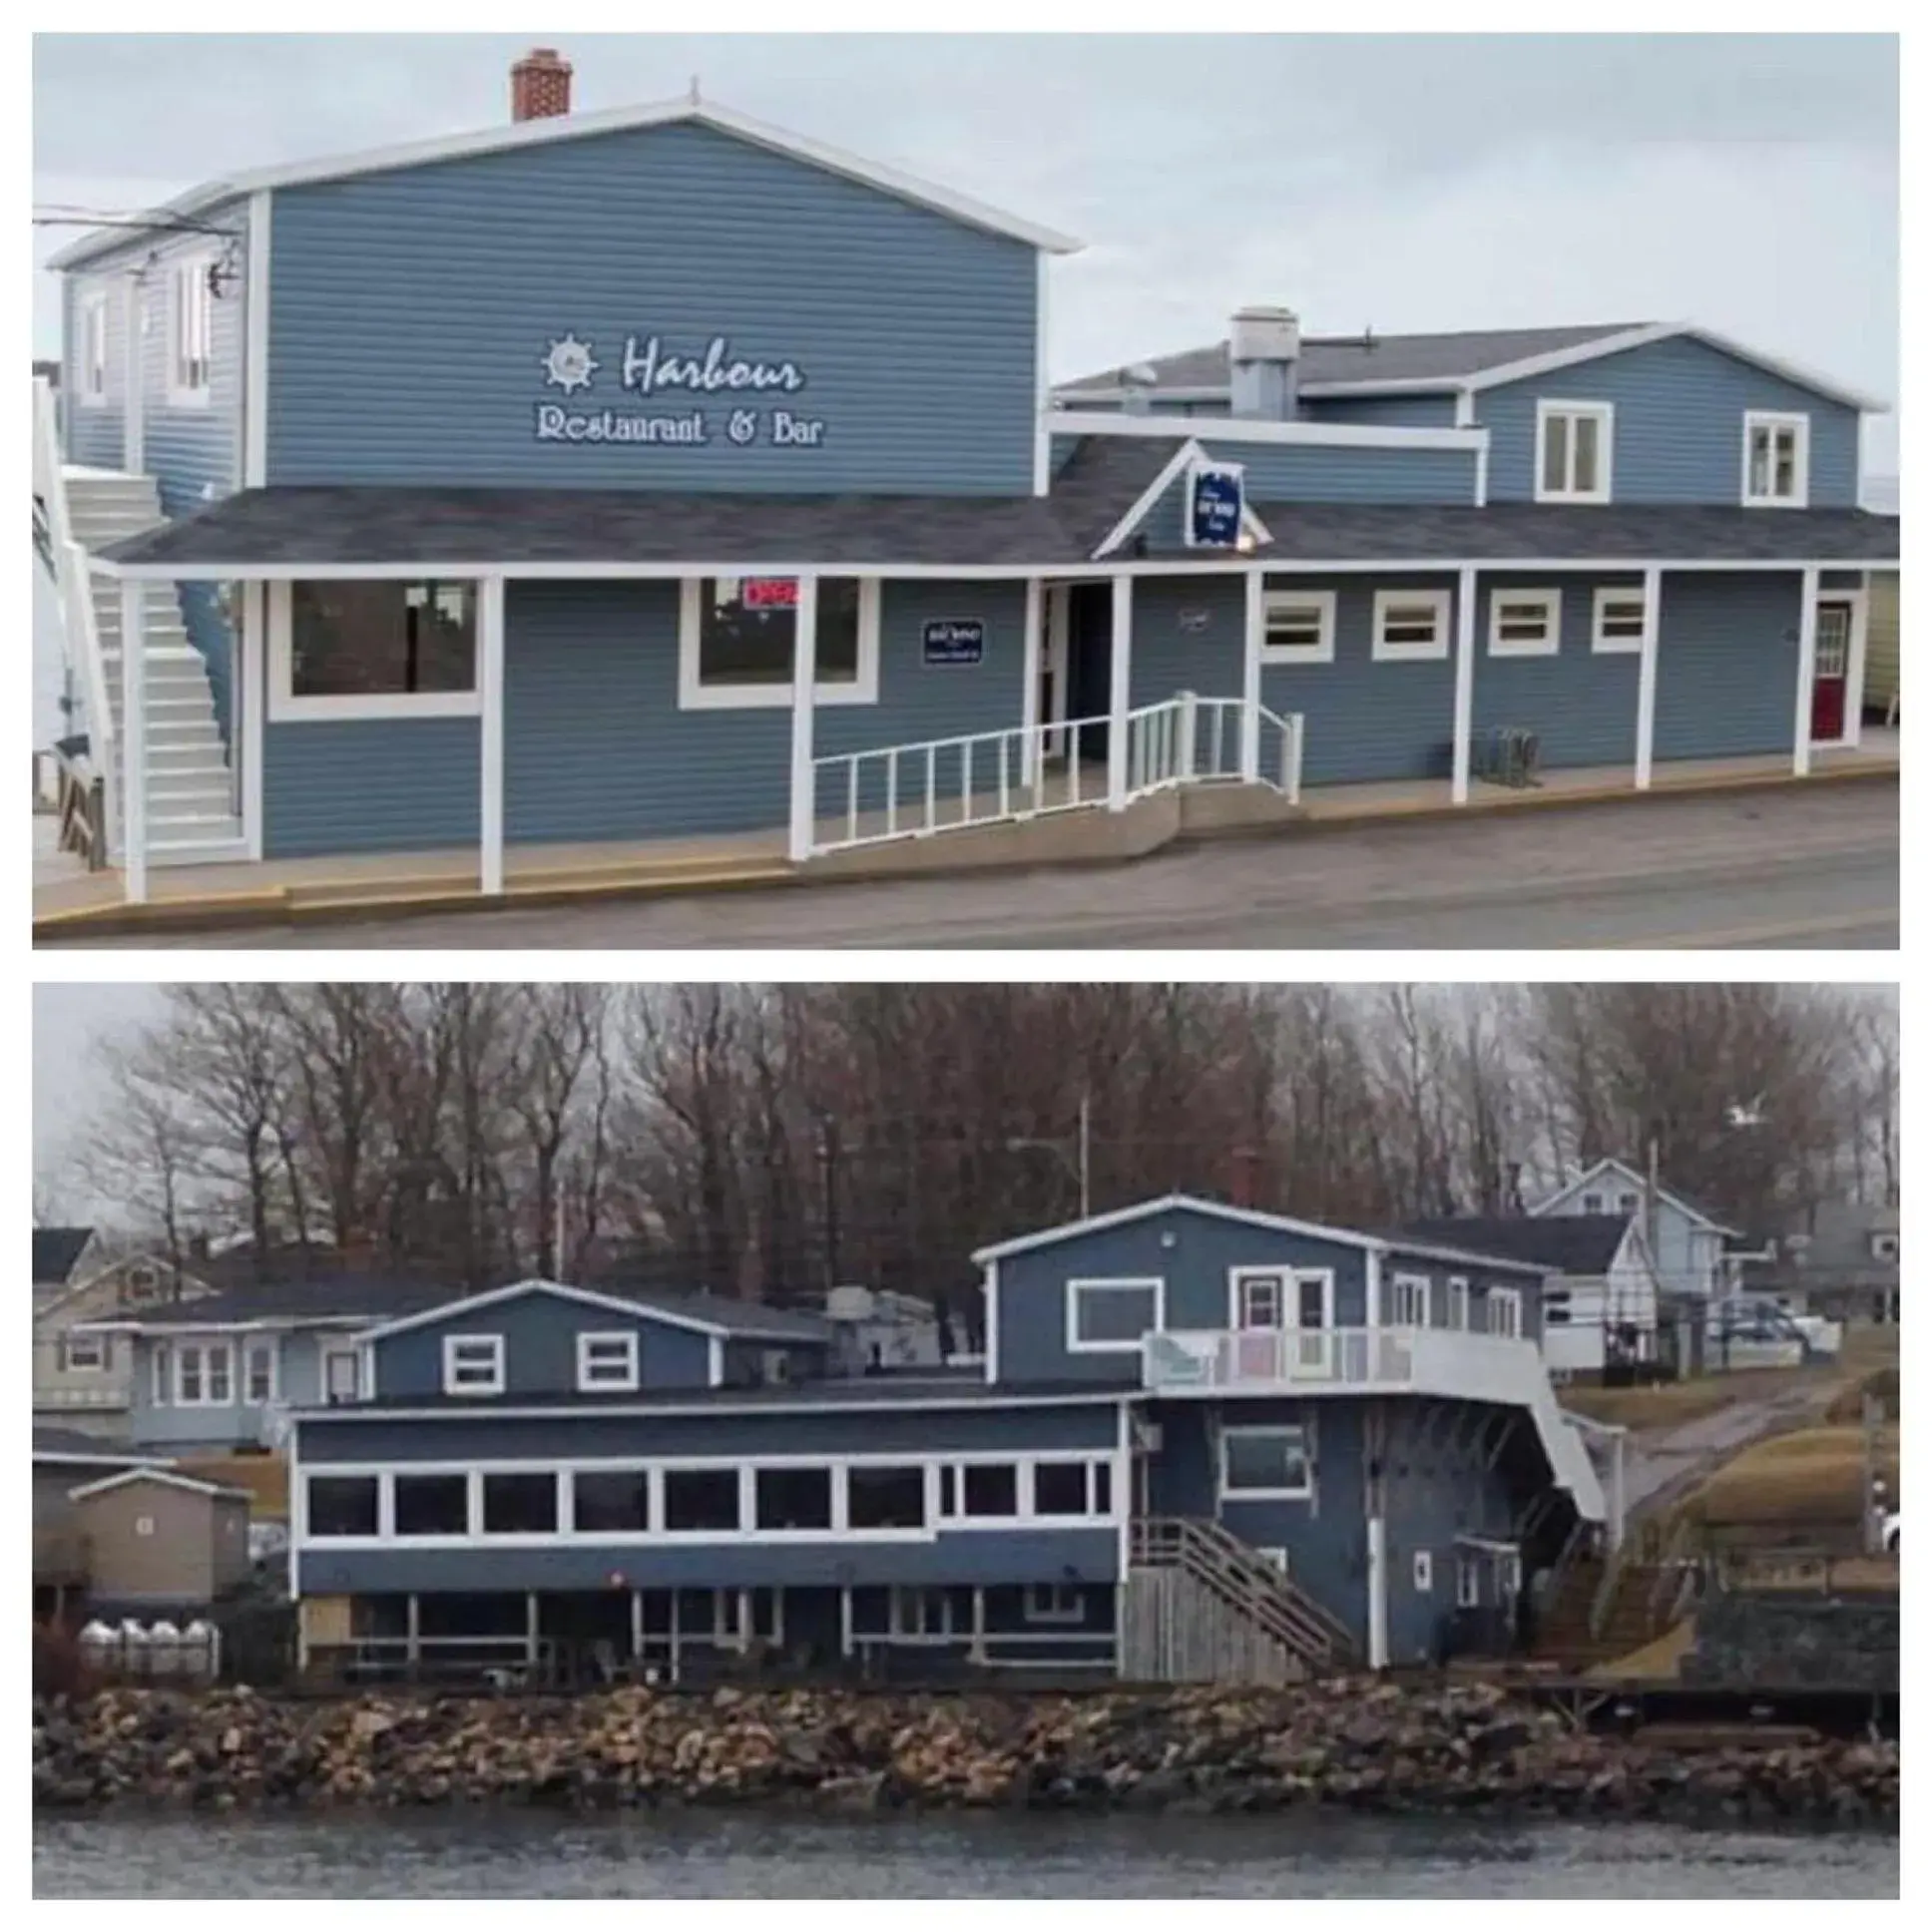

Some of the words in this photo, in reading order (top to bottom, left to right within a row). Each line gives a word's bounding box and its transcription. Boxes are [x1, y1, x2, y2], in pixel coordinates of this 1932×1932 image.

[623, 335, 804, 393] Harbour
[536, 405, 709, 443] Restaurant
[729, 409, 756, 445] &
[773, 412, 824, 445] Bar
